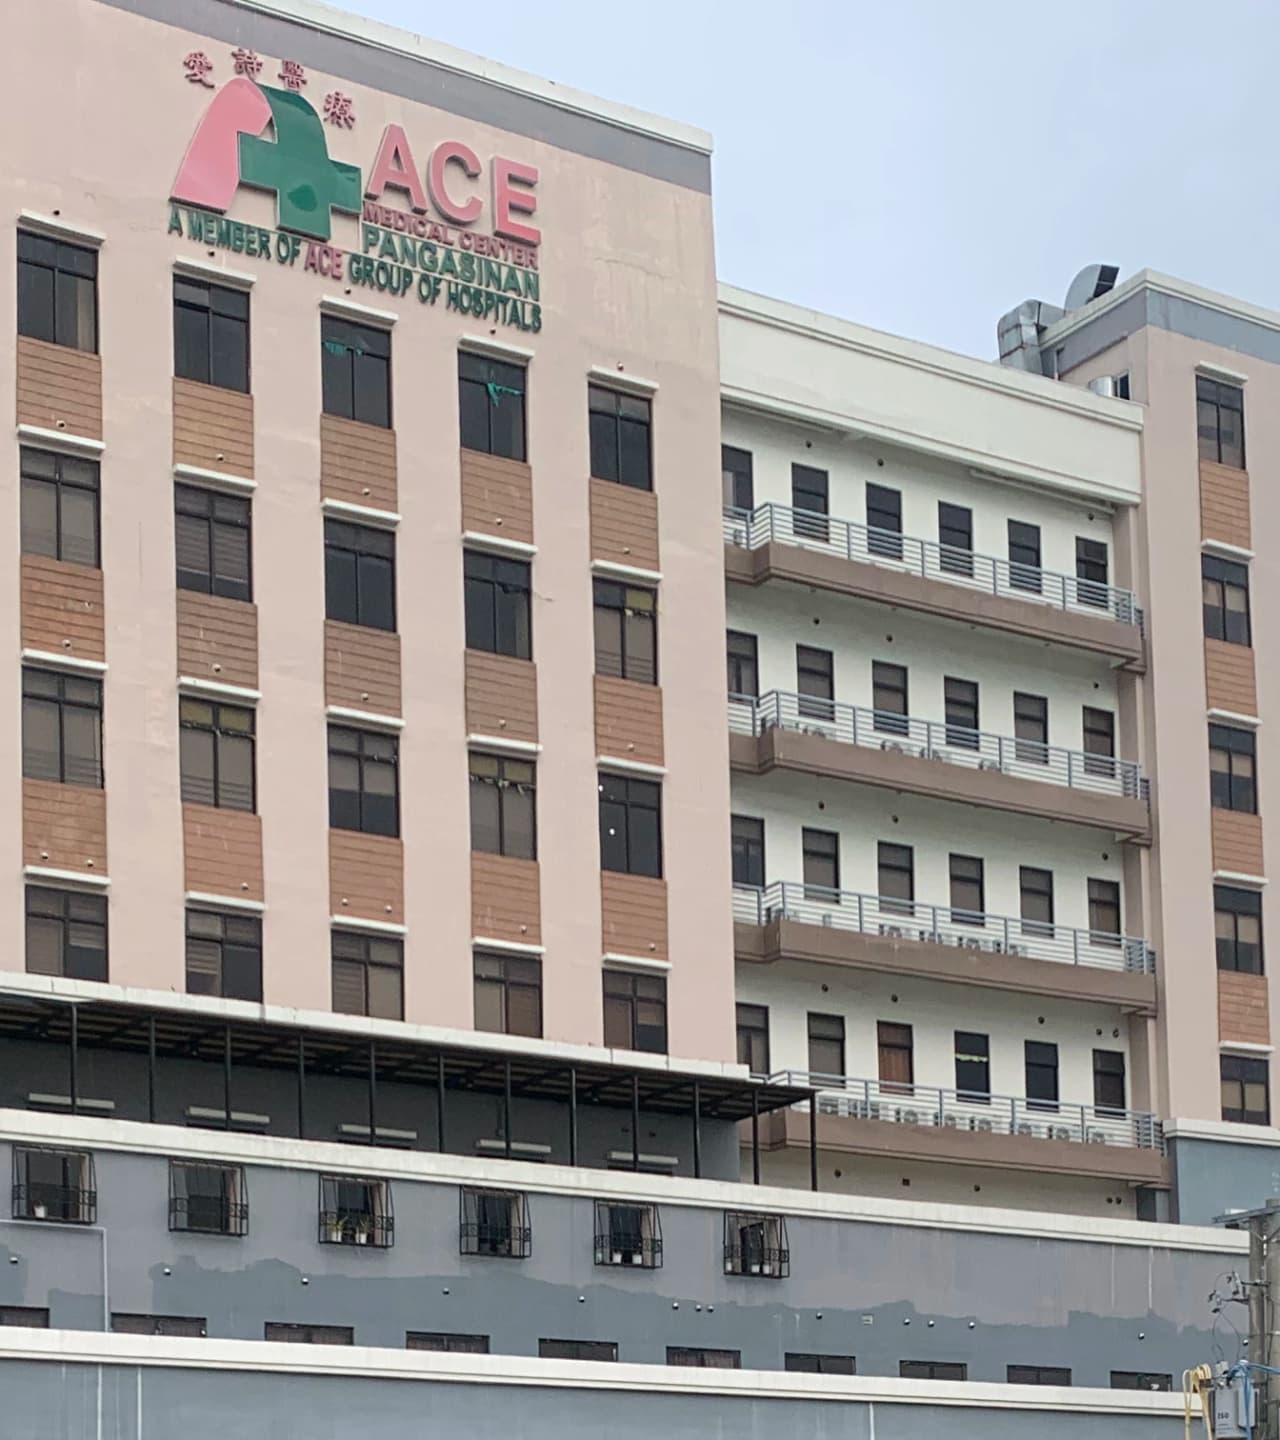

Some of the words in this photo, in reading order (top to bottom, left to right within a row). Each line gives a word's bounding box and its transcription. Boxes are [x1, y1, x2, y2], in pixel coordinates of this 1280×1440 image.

[363, 200, 455, 246] MEDICAL
[458, 230, 539, 270] CENTER
[365, 123, 542, 247] ACE
[168, 204, 183, 237] A
[187, 210, 271, 260] MEMBER
[277, 232, 302, 266] OF
[304, 241, 343, 280] ACE
[349, 253, 413, 297] GROUP
[418, 273, 442, 306] OF
[445, 280, 542, 333] HOSPITALS
[362, 222, 540, 301] PANGASINAN
